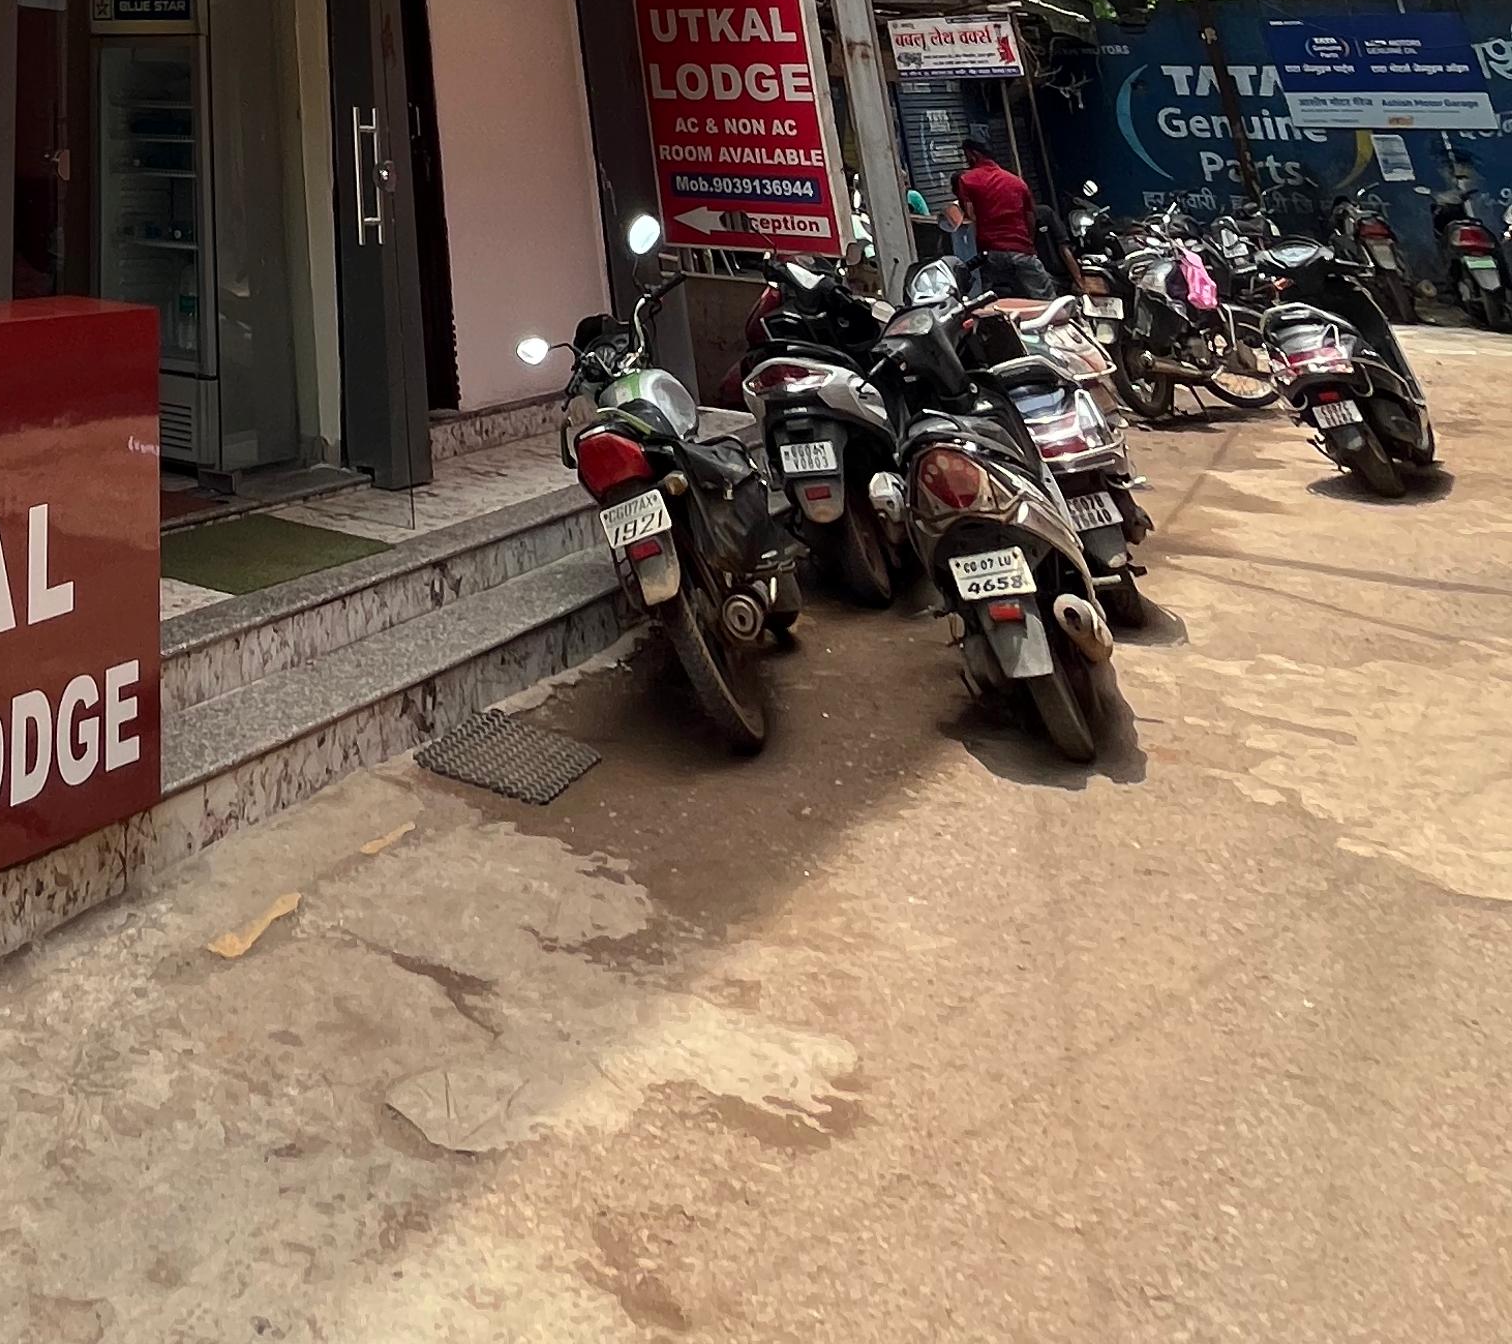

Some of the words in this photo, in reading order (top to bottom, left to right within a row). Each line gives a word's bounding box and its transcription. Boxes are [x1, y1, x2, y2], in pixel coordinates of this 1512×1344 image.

[119, 0, 151, 12] BLUE
[154, 0, 186, 12] STAR
[649, 7, 797, 43] UTKAL
[648, 62, 815, 103] LODGE
[675, 117, 699, 134] AC
[706, 118, 718, 134] &
[725, 117, 766, 136] NON
[772, 118, 797, 137] AC
[659, 144, 713, 163] ROOM
[718, 146, 824, 168] AVAILABLE
[676, 175, 814, 198] Mob.9039136944
[750, 213, 820, 234] ception
[613, 509, 663, 547] 1921
[968, 575, 1023, 594] 4658
